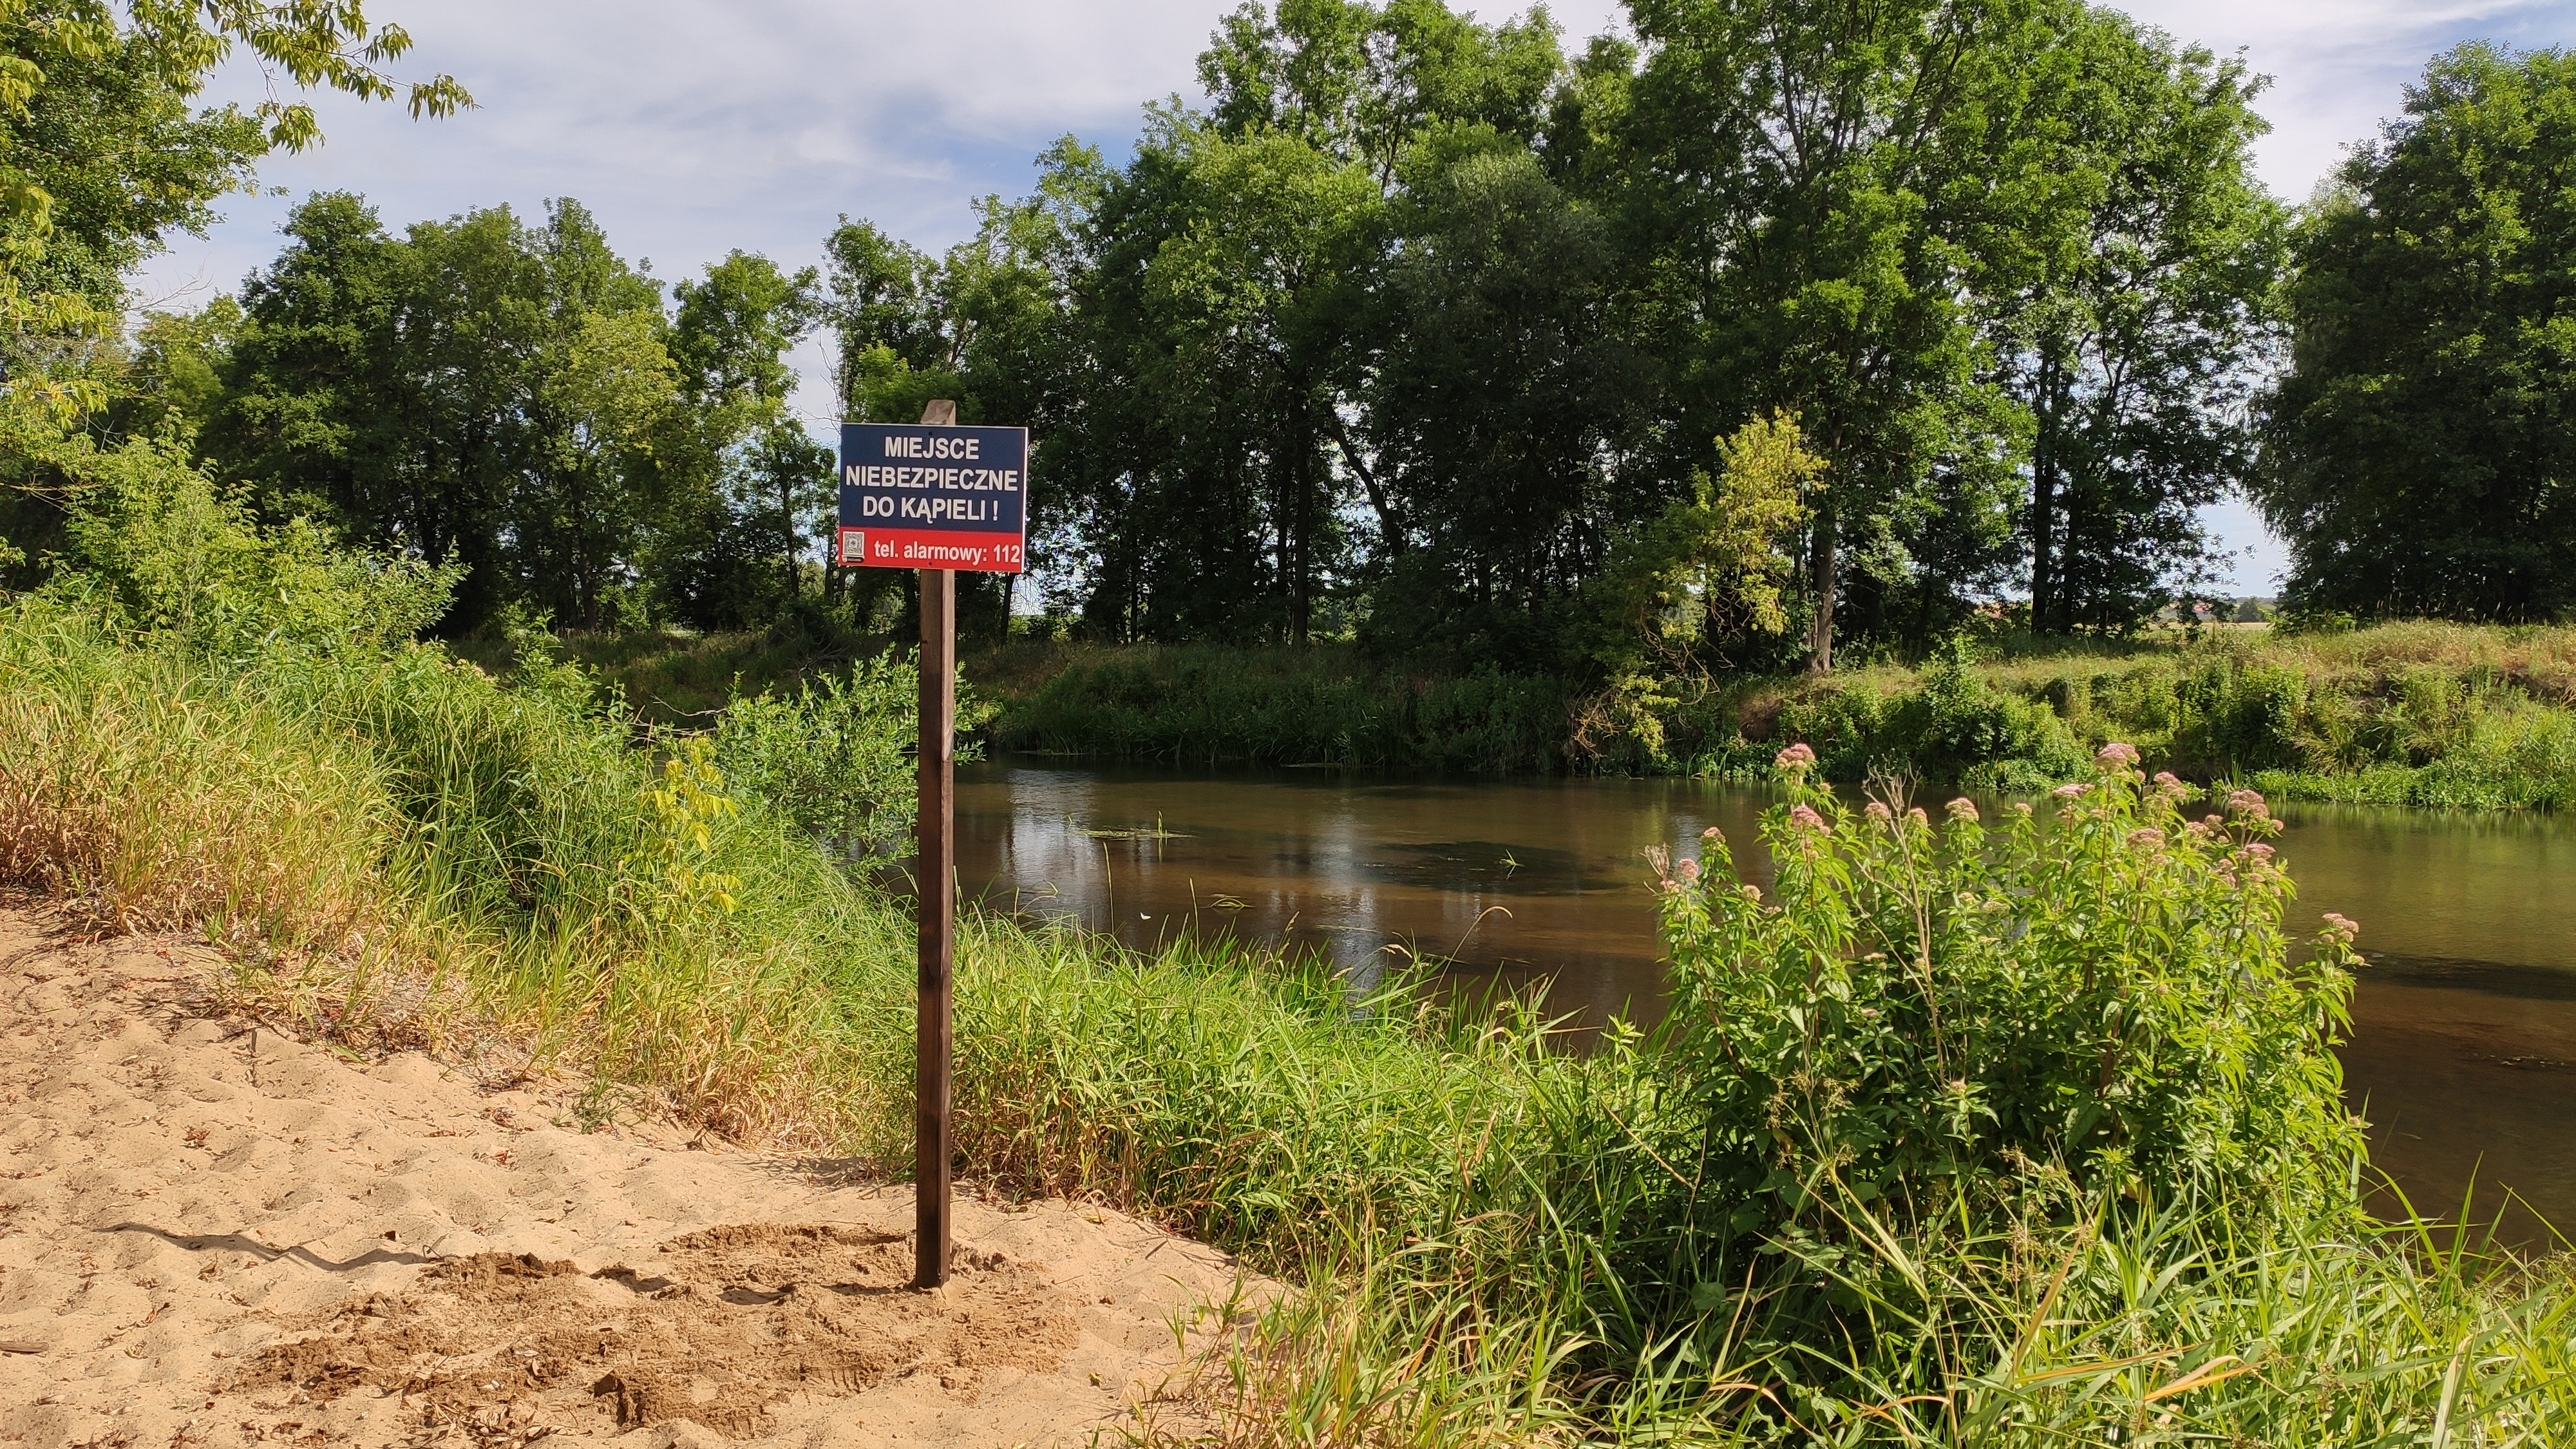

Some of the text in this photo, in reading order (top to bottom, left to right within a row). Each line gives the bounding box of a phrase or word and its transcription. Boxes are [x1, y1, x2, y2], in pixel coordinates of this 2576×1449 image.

[885, 436, 980, 460] MIEJSCE
[846, 465, 1018, 491] NIEBEZPIECZNE
[863, 496, 895, 517] DO
[901, 497, 985, 524] KĄPIELI
[874, 540, 1020, 566] tel. alarmowy: 112
